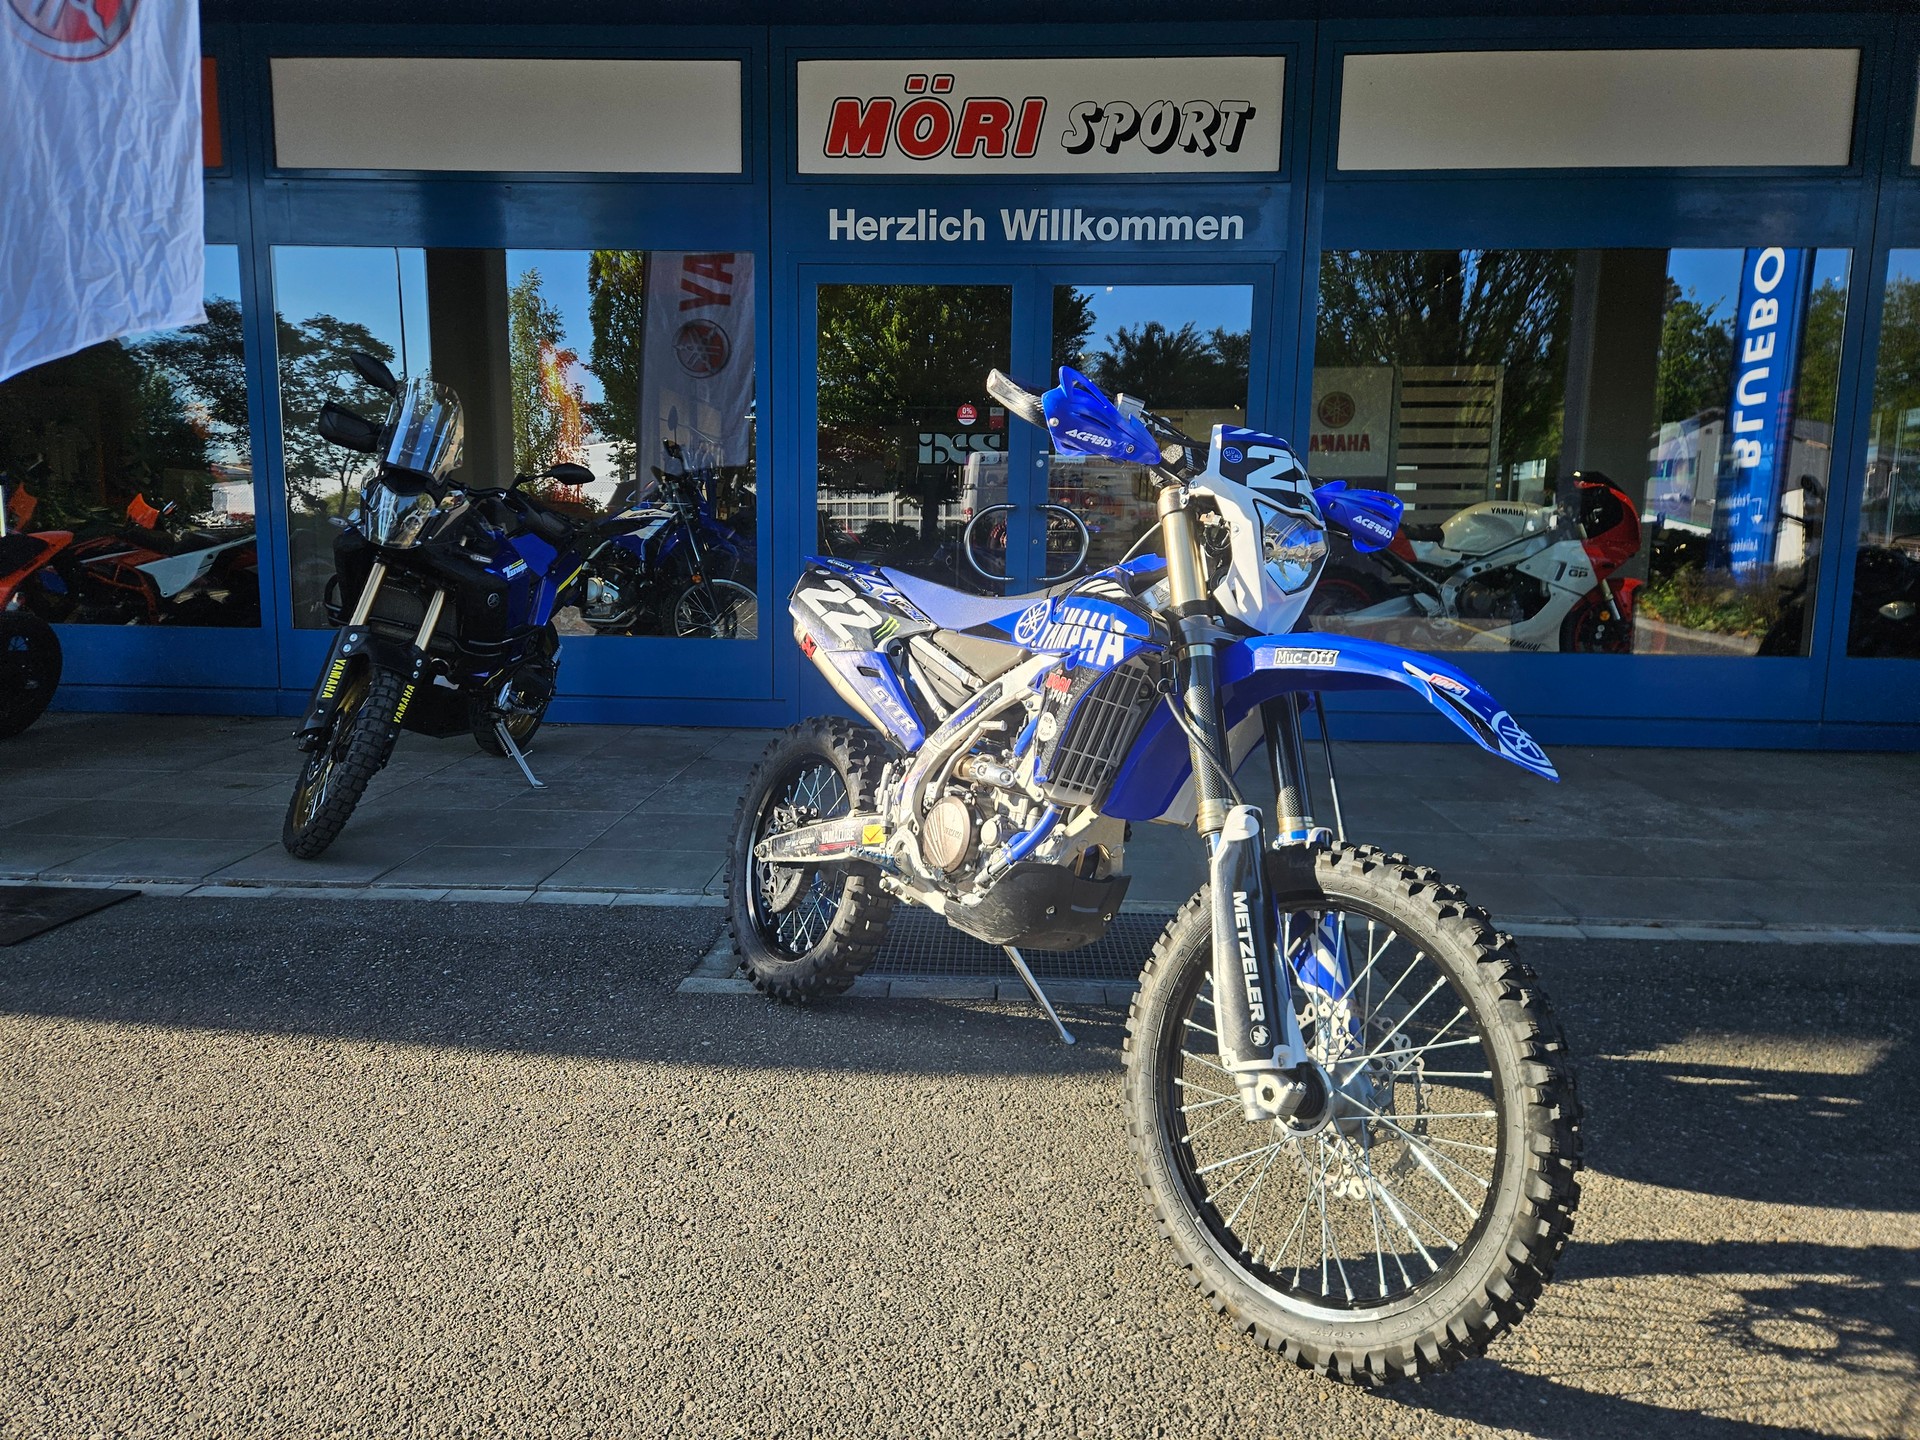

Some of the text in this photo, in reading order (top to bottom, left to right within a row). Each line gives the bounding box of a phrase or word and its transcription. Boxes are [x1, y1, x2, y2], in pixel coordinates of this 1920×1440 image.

[823, 74, 1256, 160] MÖRI SPORT
[829, 208, 1244, 241] Herzlich Willkommen
[1065, 429, 1114, 448] ACERBIS
[1491, 507, 1525, 517] YAMAHA
[1568, 569, 1589, 578] GP
[797, 579, 883, 642] 22
[1037, 606, 1128, 667] YAMAHA
[1505, 637, 1541, 651] YAMAHA
[1277, 649, 1337, 666] Muc-Off
[322, 659, 347, 699] YAMAHA
[393, 684, 415, 724] YAMAHA
[872, 687, 918, 736] GYTR
[1233, 891, 1266, 1022] METZELER
